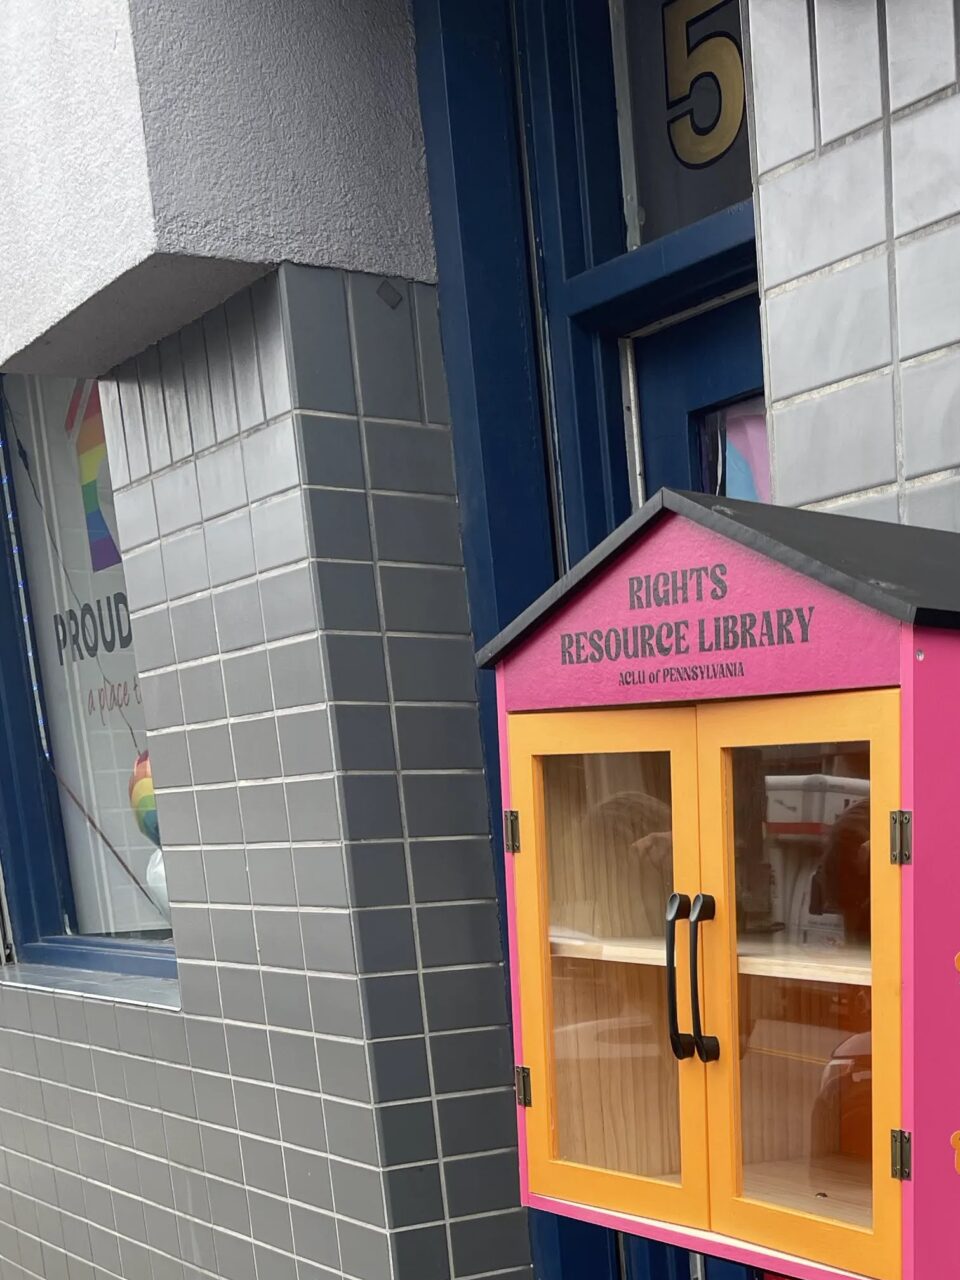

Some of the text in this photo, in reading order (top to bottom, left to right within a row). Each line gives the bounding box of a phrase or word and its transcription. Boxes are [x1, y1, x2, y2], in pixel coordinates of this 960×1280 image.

[662, 0, 745, 169] 5
[628, 563, 727, 609] RIGHTS
[53, 592, 132, 666] PROUD
[560, 606, 815, 665] RESOURCE LIBRARY
[618, 661, 745, 686] ACLU of PENNSYLVANIA
[98, 681, 130, 726] place
